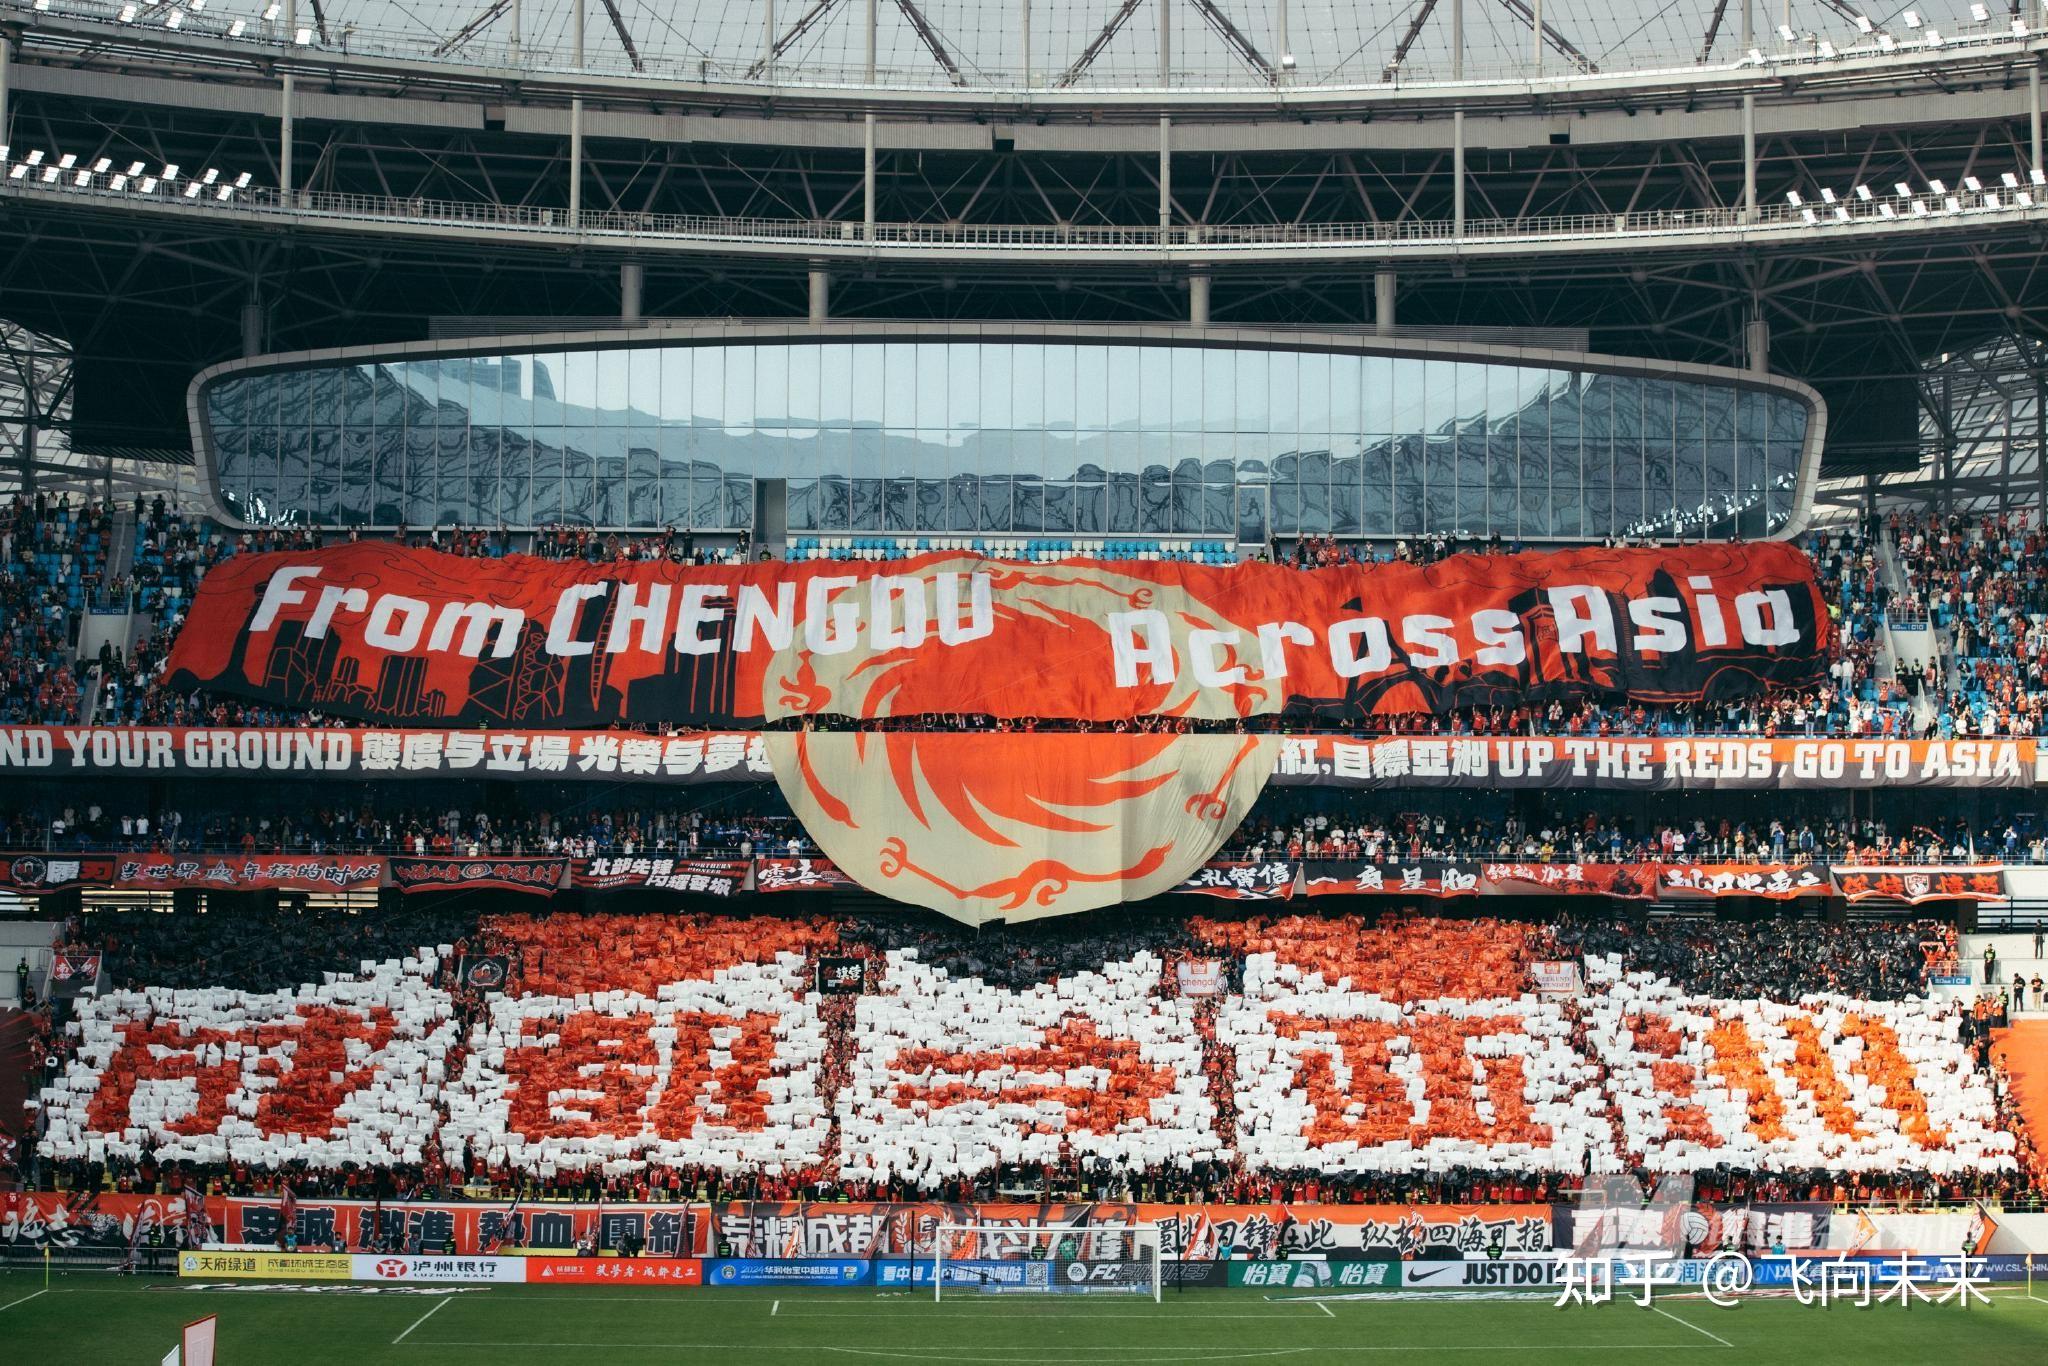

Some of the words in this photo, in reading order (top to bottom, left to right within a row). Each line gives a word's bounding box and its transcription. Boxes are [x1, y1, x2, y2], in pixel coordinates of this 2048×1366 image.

[249, 565, 524, 659] From
[546, 572, 996, 657] CHENGDU
[1112, 607, 1525, 688] Across
[1546, 575, 1801, 654] Asia
[64, 730, 176, 768] YOUR
[184, 731, 352, 770] GROUND
[1496, 740, 1554, 778] UP
[1565, 740, 1653, 780] THE
[1793, 743, 1845, 779] GO
[1854, 743, 1901, 778] TO
[1920, 742, 2021, 778] ASIA
[200, 1257, 256, 1272] 天府绿道
[267, 1259, 349, 1269] 成都环城生态区
[413, 1261, 498, 1273] 泸州银行
[1242, 1263, 1292, 1286] 怡寶
[1339, 1263, 1389, 1286] 怡寶
[1462, 1262, 1509, 1285] JUST
[1513, 1262, 1543, 1285] DO
